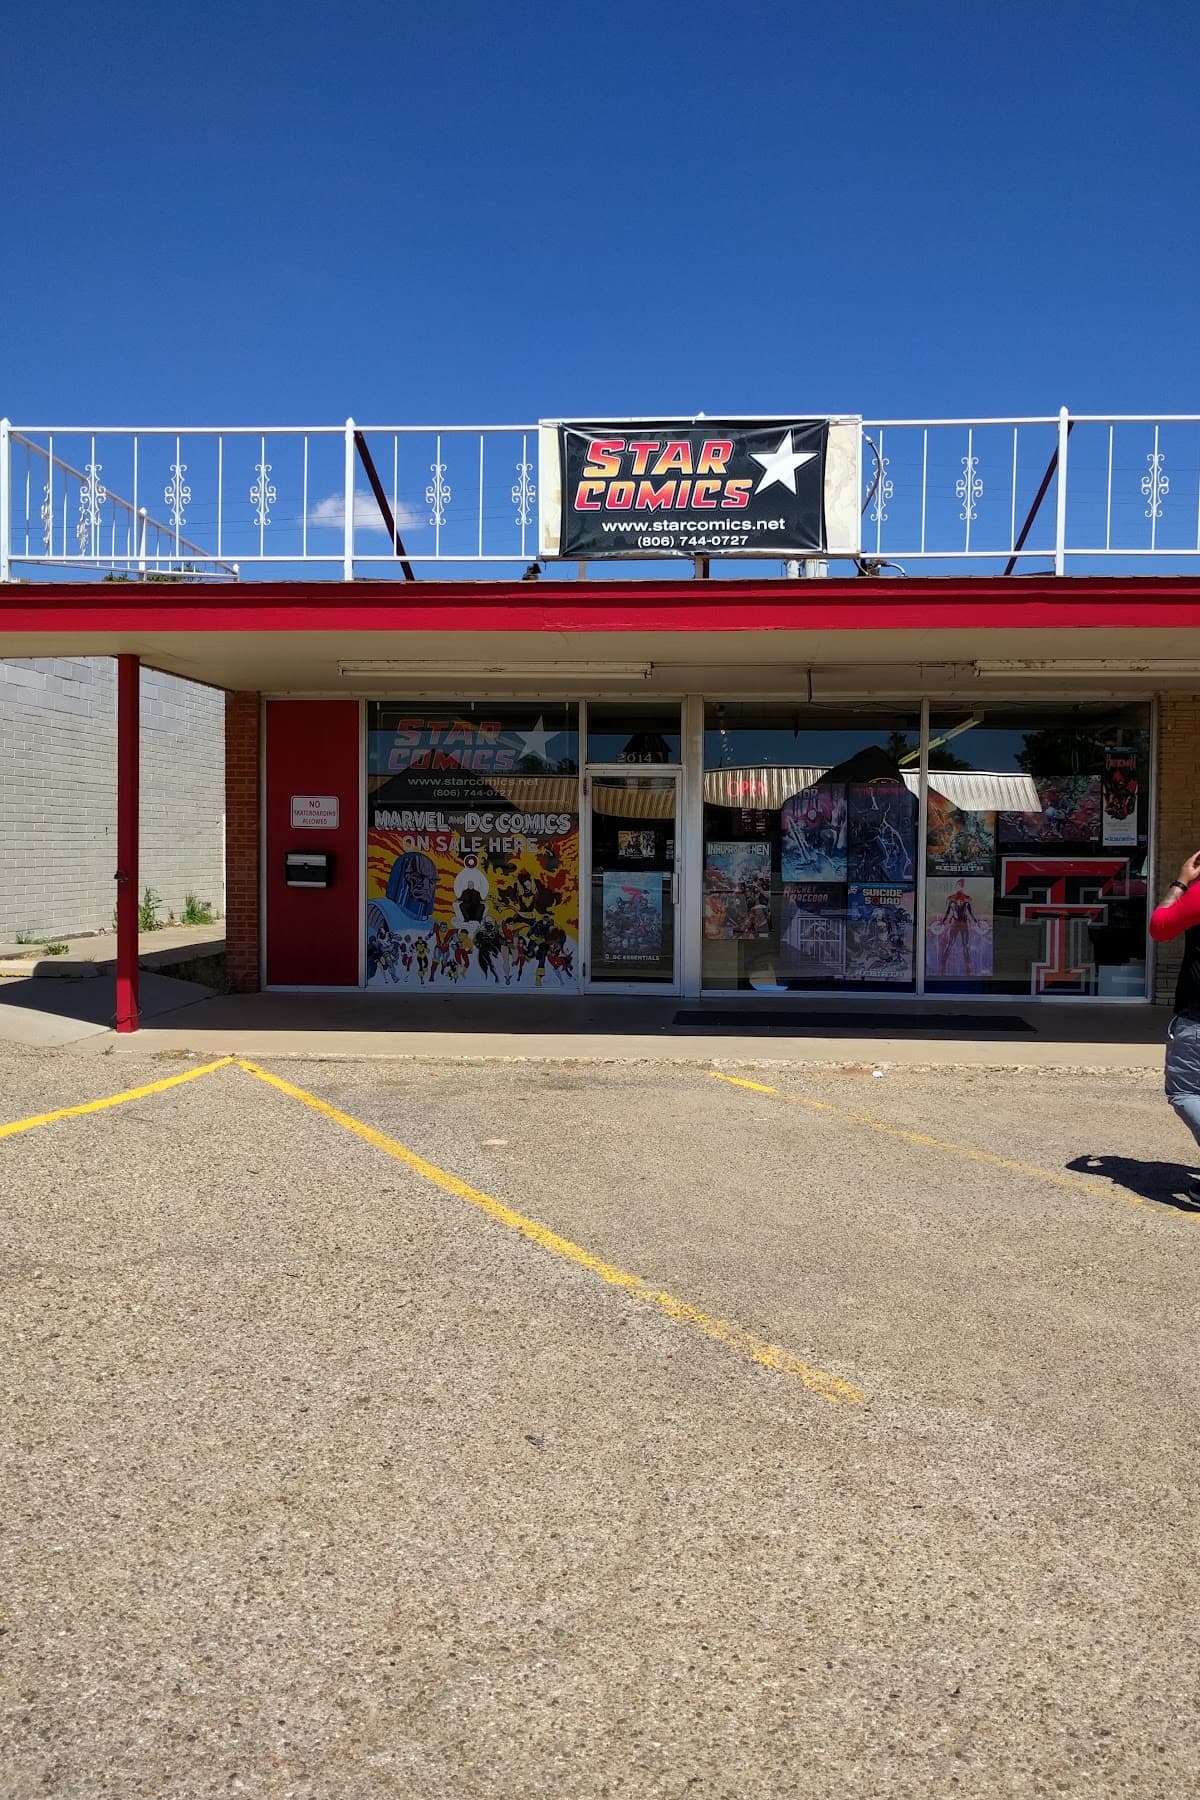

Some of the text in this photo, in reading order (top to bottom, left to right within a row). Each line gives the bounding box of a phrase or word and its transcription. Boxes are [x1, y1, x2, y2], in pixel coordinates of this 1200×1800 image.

[583, 439, 734, 477] STAR
[574, 479, 752, 513] COMICS
[601, 518, 786, 532] www.starcomics.net
[637, 535, 749, 548] (806) 744-0727
[394, 719, 501, 746] STAR
[388, 748, 516, 770] COMICS
[616, 752, 652, 763] 2014
[407, 776, 539, 787] www.starcomics.net
[433, 789, 461, 799] (806)
[727, 781, 769, 798] OPEN
[309, 800, 321, 809] NO
[374, 809, 450, 833] MARVEL
[464, 812, 495, 834] DC
[494, 812, 572, 835] COMICS
[402, 835, 538, 853] ON SALE HERE
[862, 888, 903, 897] SUICIDE
